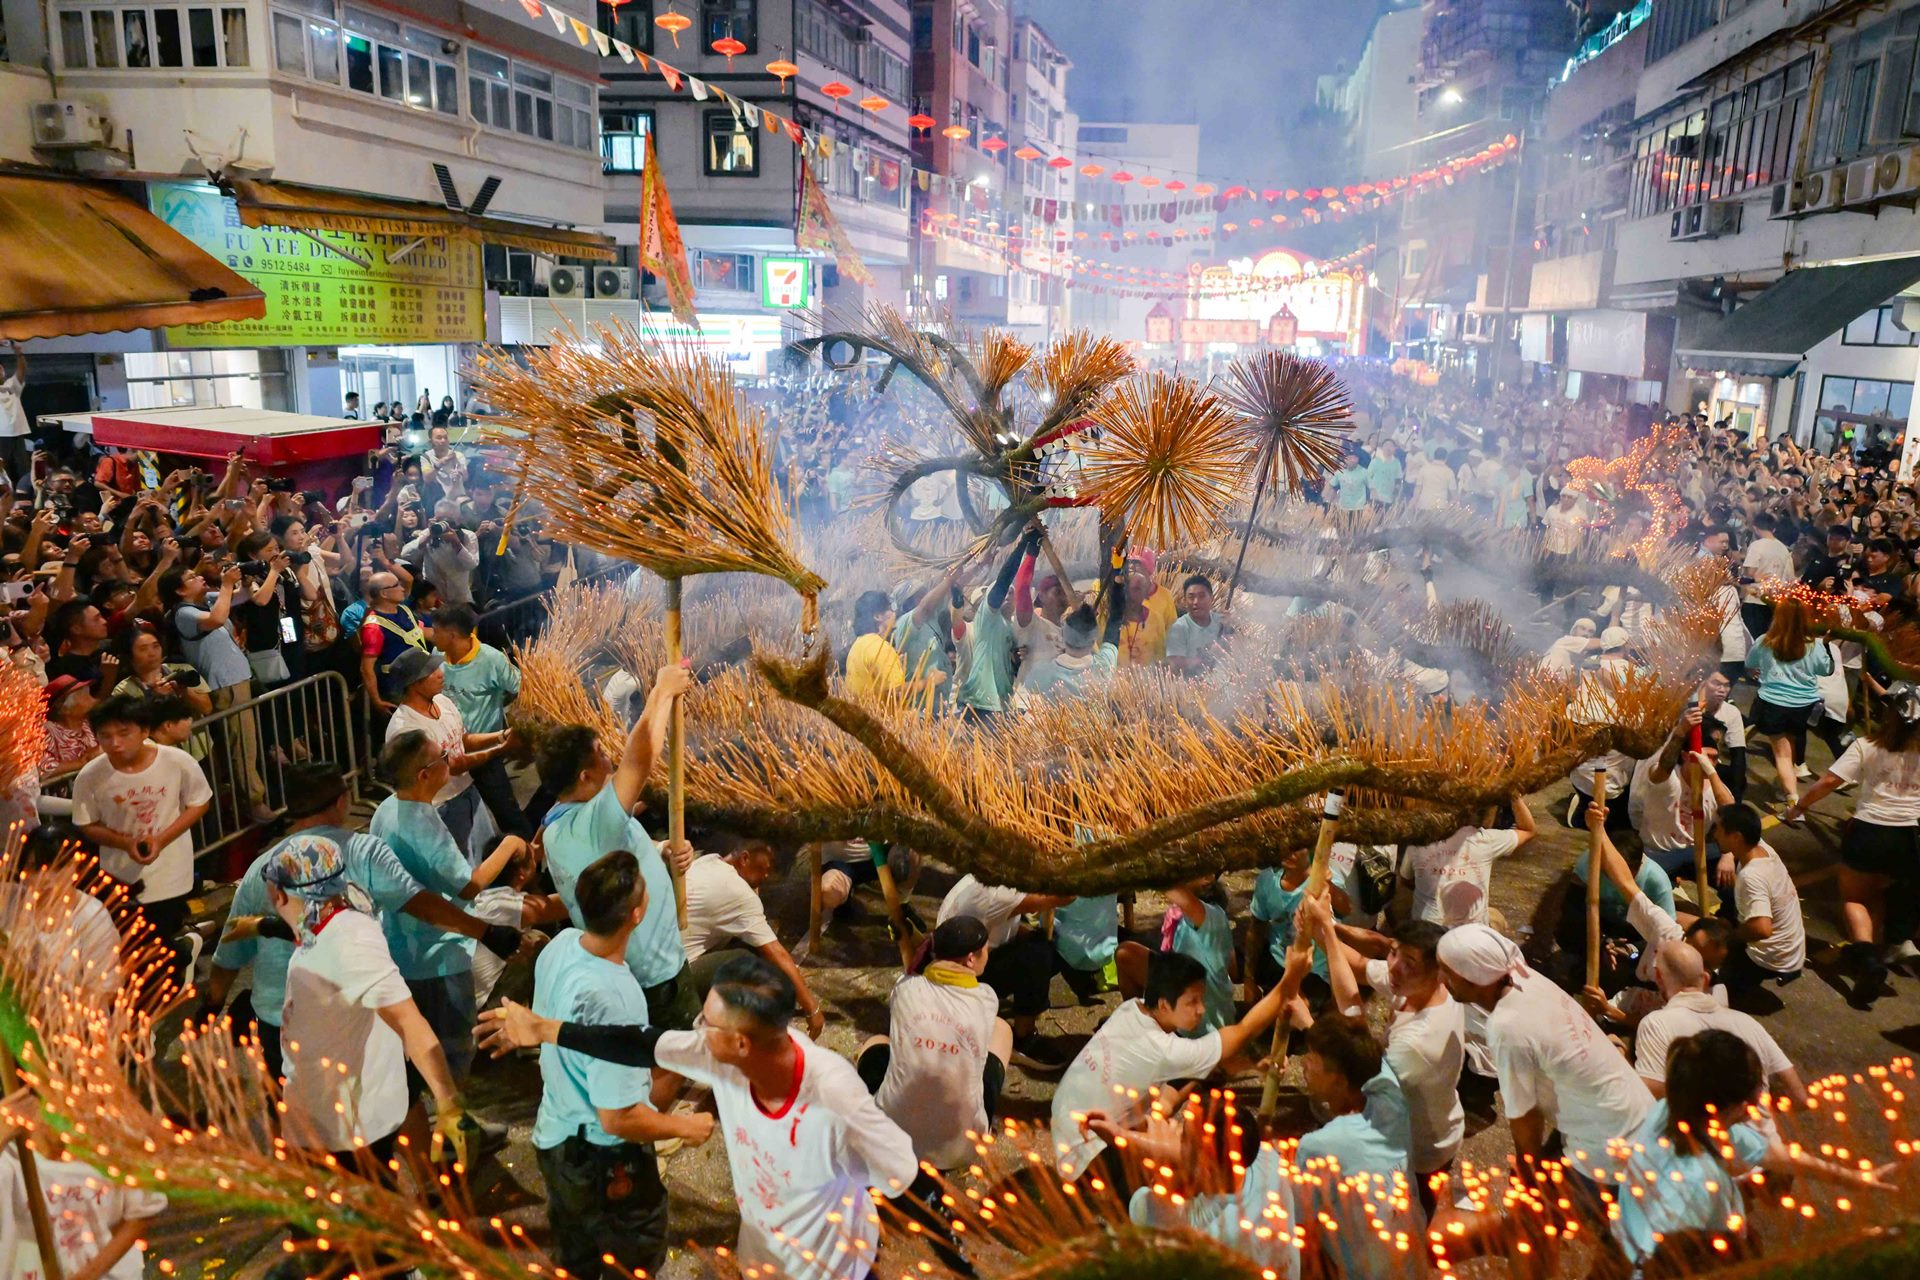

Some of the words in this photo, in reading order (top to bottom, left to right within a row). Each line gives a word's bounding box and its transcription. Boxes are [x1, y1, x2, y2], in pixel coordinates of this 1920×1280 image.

[379, 219, 411, 233] FISH
[225, 232, 250, 251] FU
[261, 237, 301, 256] YEE
[310, 242, 374, 262] DEGN
[261, 259, 285, 271] 9512
[287, 261, 311, 273] 5484
[281, 294, 322, 307] 泥水油漆
[282, 309, 323, 321] 冷氣工程
[914, 1037, 959, 1055] 2026
